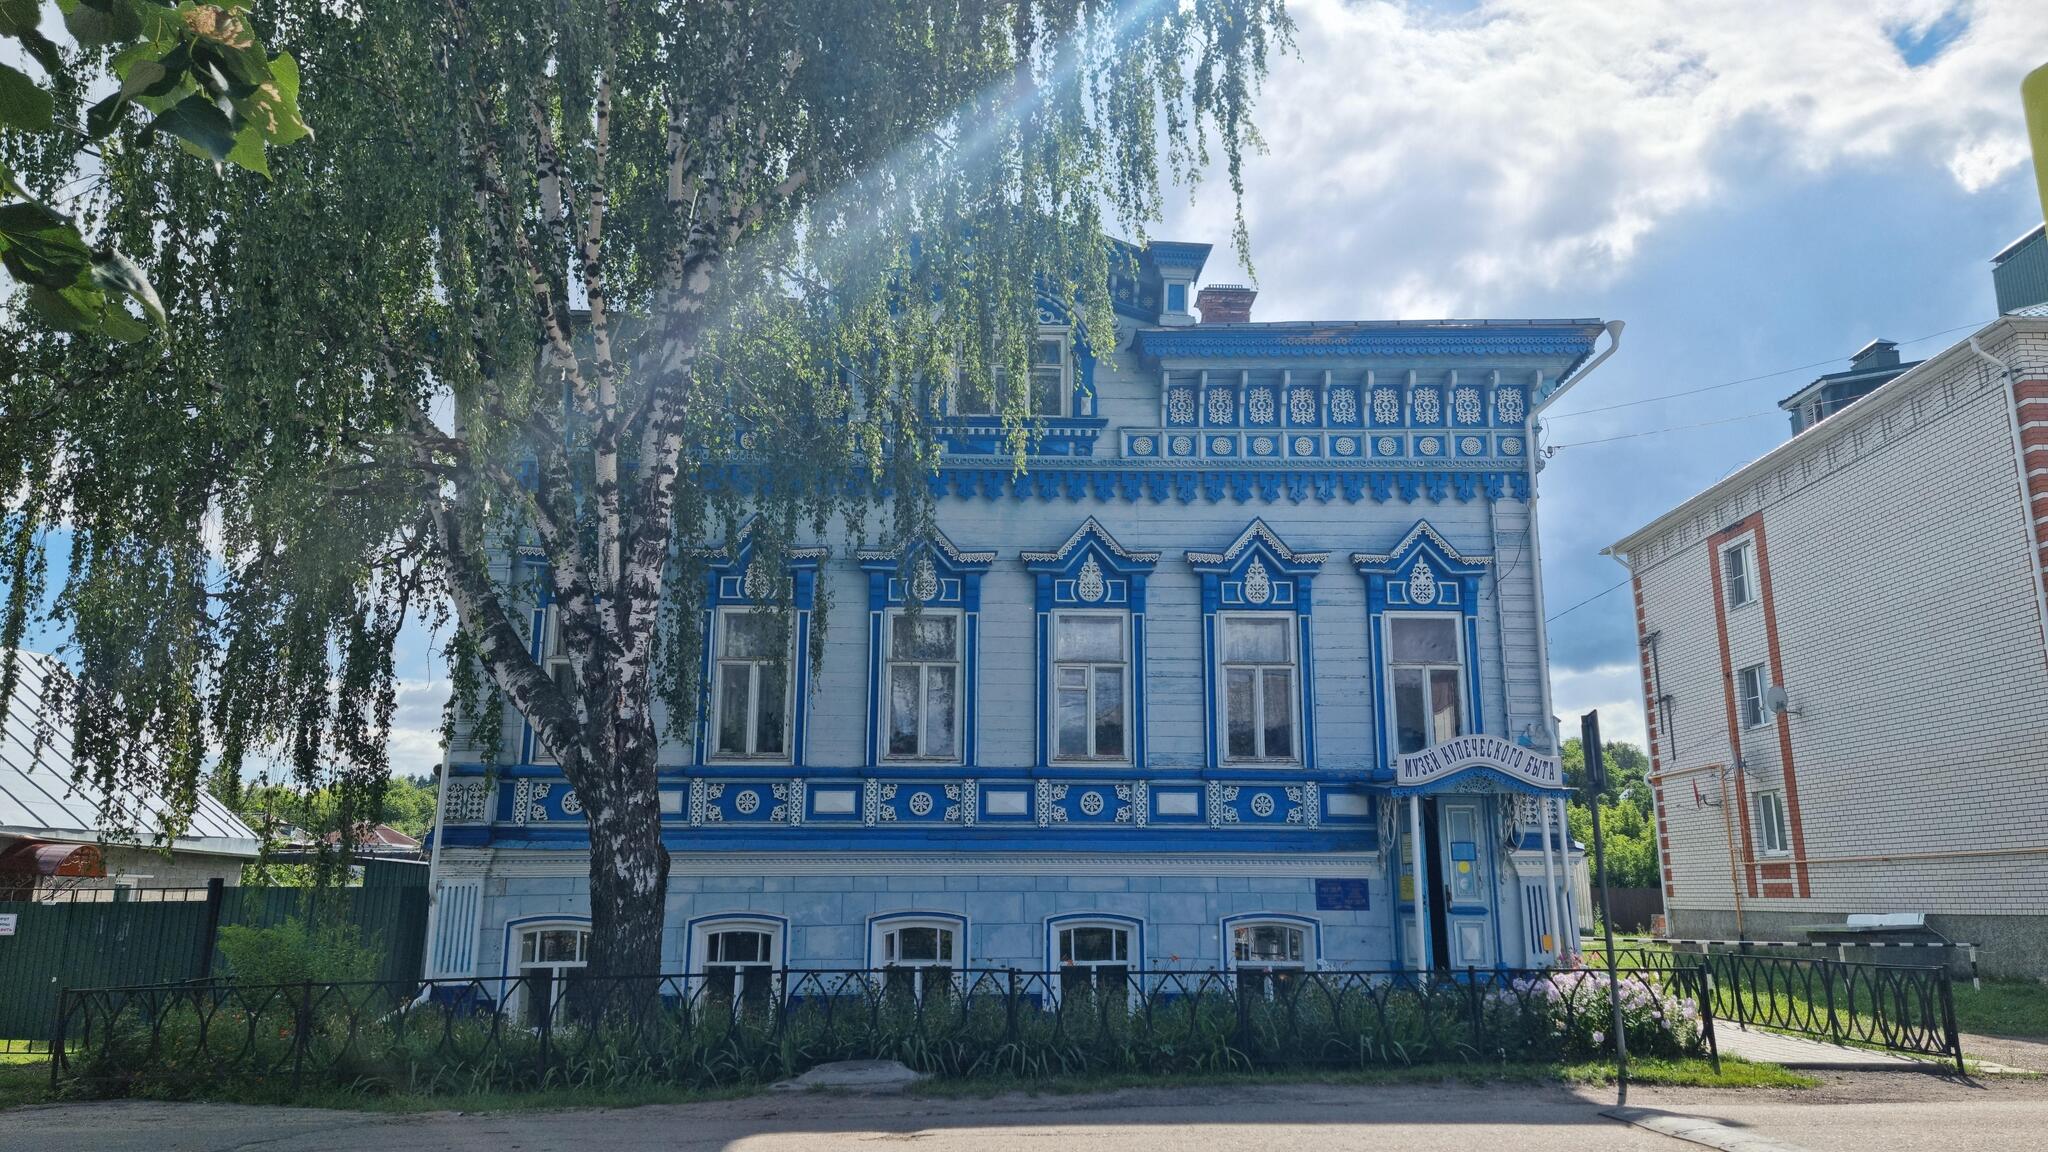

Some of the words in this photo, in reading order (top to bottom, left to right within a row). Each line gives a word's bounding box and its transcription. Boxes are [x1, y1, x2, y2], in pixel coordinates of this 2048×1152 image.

[1404, 749, 1441, 778] МУЗЕЙ
[1440, 738, 1524, 768] КУПЕЧЕСКОГО
[1524, 755, 1555, 781] БЫТА
